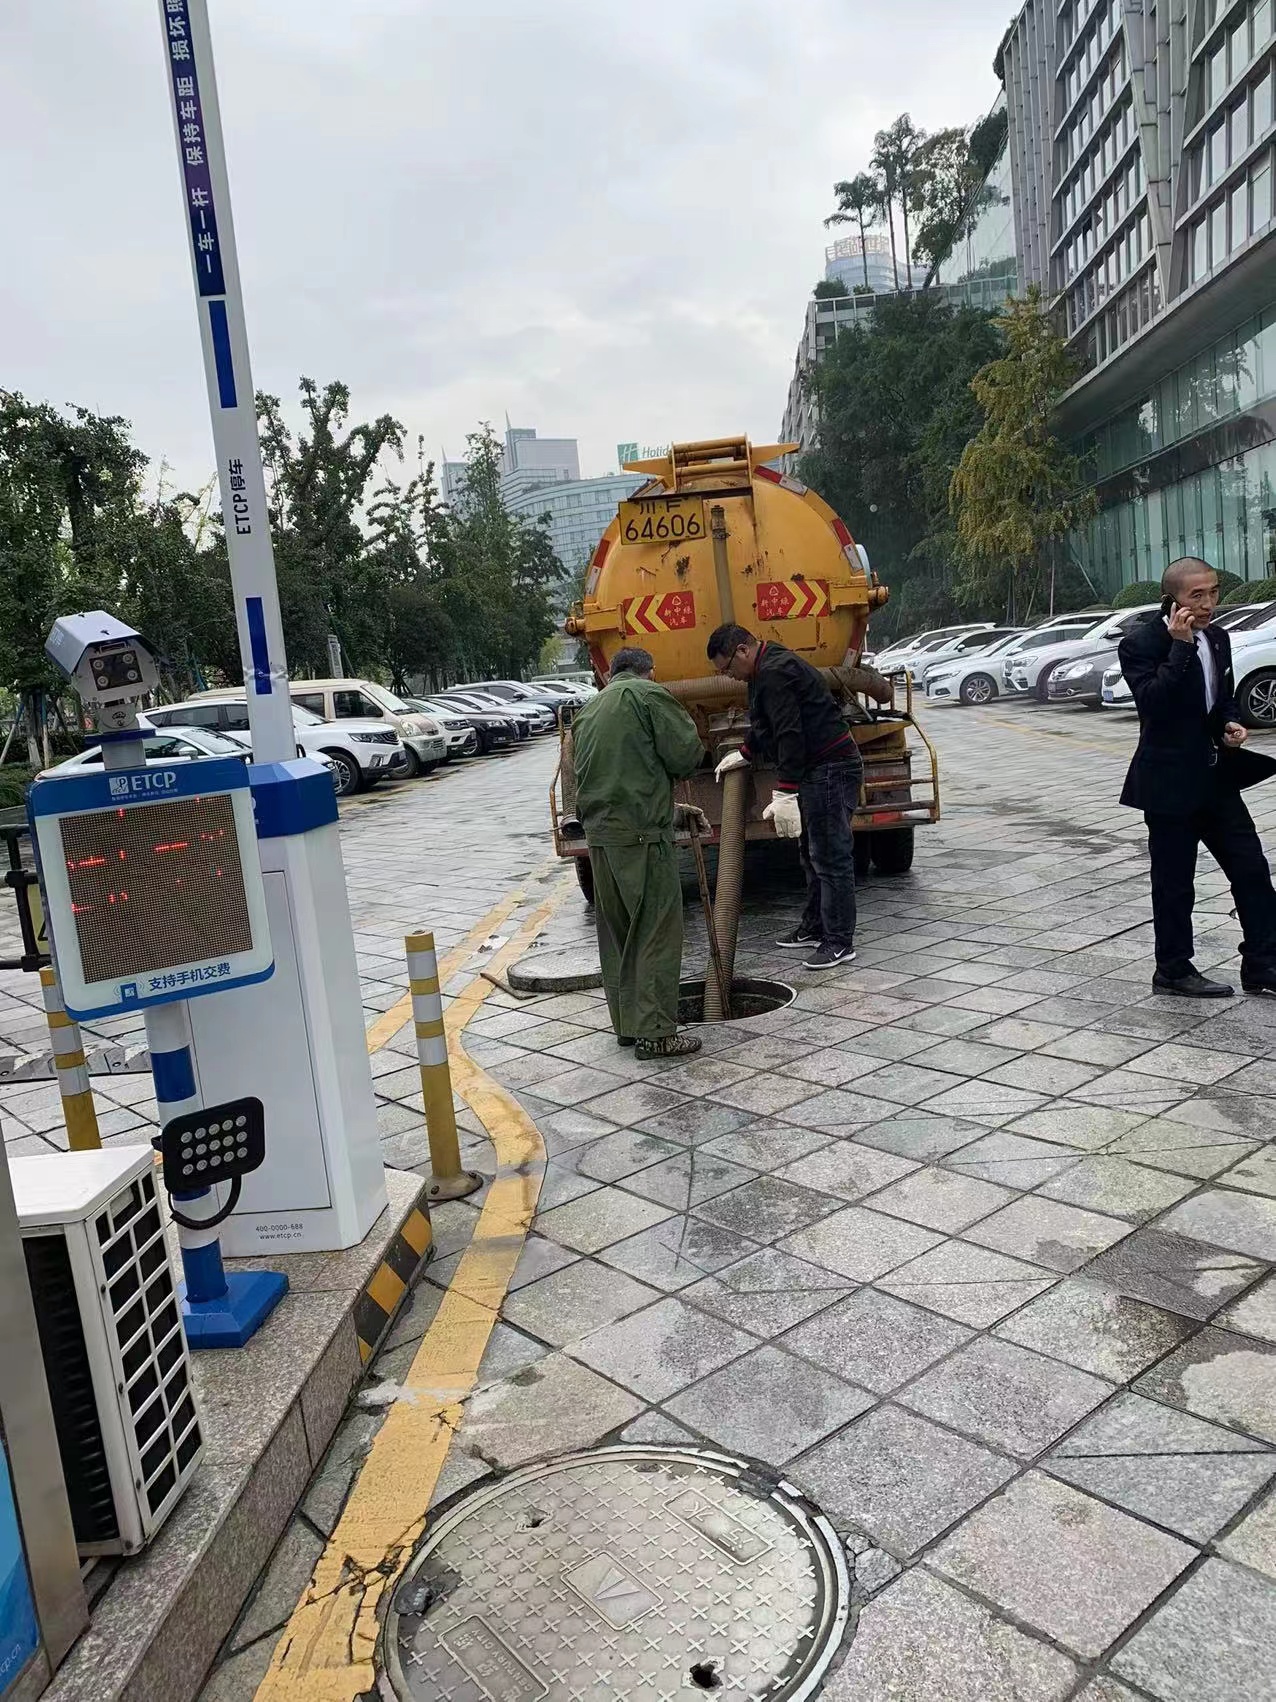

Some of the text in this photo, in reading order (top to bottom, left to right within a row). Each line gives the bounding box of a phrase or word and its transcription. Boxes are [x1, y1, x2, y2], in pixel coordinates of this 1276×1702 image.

[177, 75, 204, 166] 保持车距
[192, 187, 214, 273] 一车一杆
[642, 445, 672, 458] Holid
[625, 513, 700, 541] 64606
[131, 771, 177, 790] ETCP
[148, 962, 231, 992] 支持手机交费
[259, 1231, 302, 1240] www.etcp.cn
[683, 1501, 754, 1552] 污水
[471, 1629, 533, 1692] CENTURY CITY
